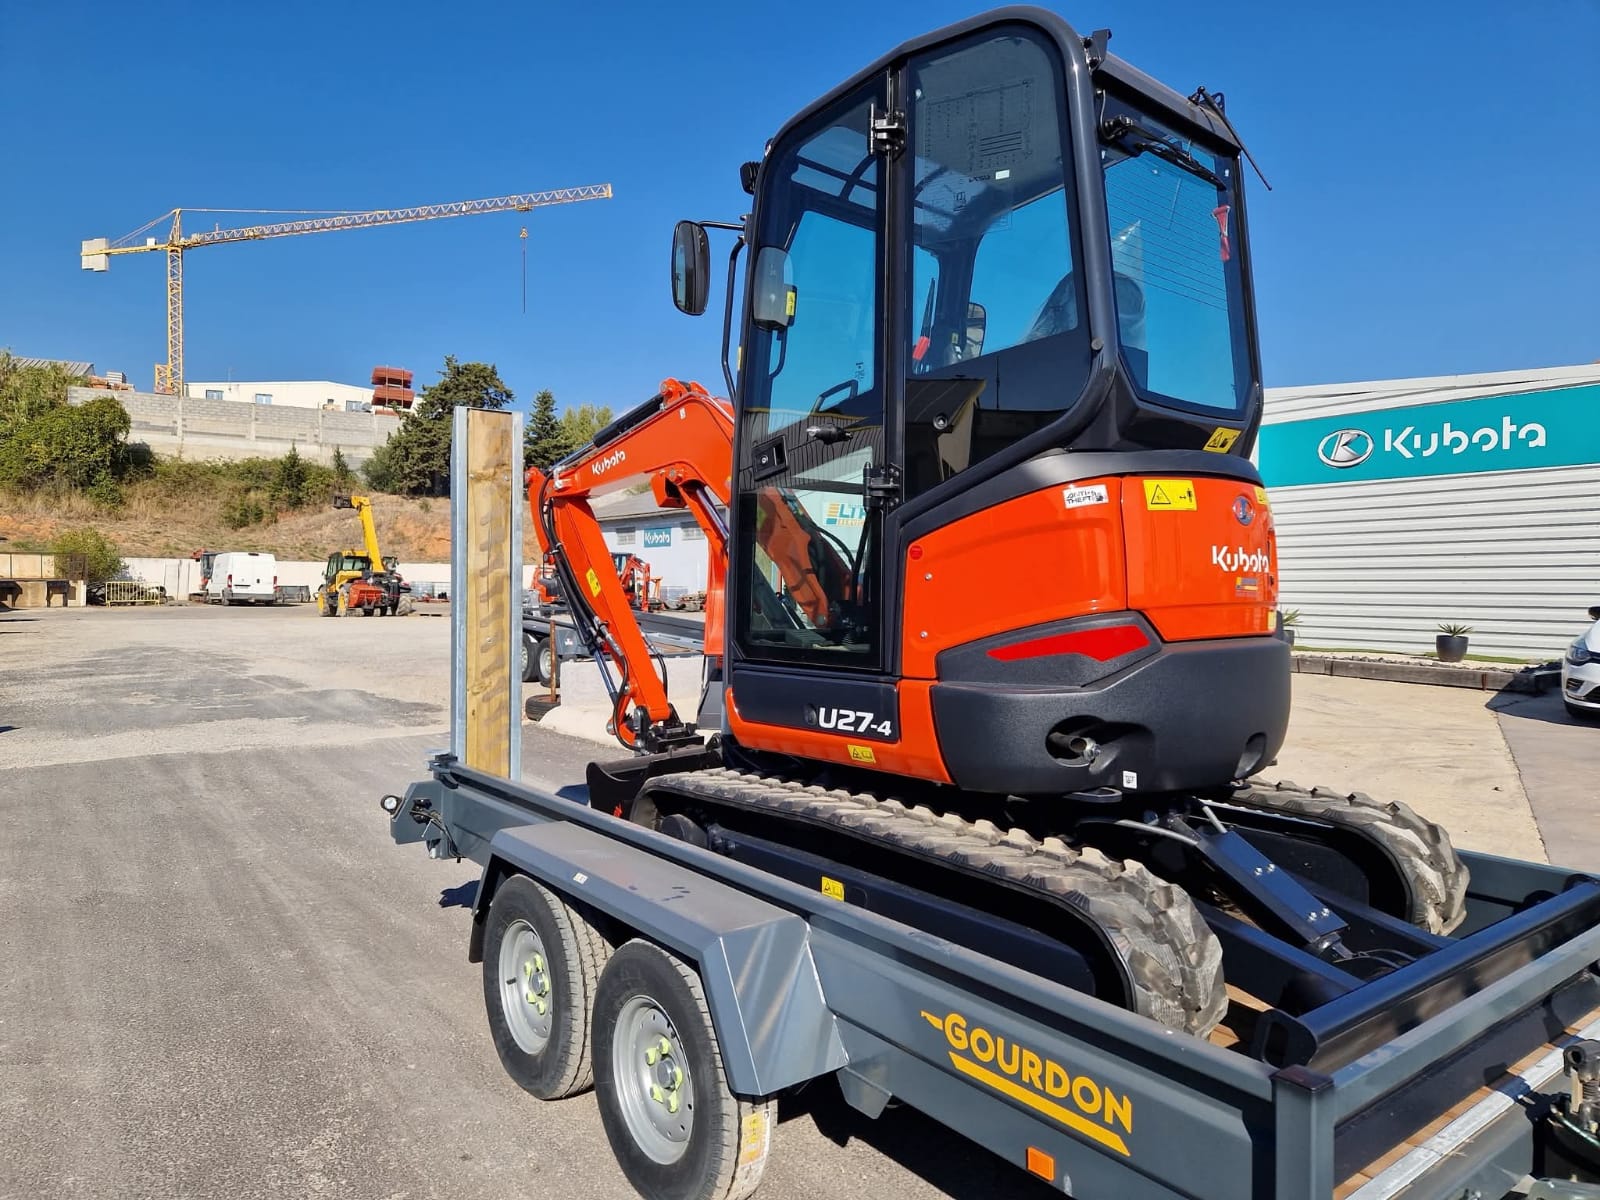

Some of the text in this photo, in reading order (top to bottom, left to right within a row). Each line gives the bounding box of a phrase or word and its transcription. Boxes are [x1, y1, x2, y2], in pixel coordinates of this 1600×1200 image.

[1384, 416, 1546, 459] Kubota
[592, 450, 626, 475] Kubota
[644, 531, 671, 545] Kubota
[1211, 545, 1270, 573] Kubota
[818, 706, 892, 737] U27-4
[943, 1012, 1133, 1135] GOURDON
